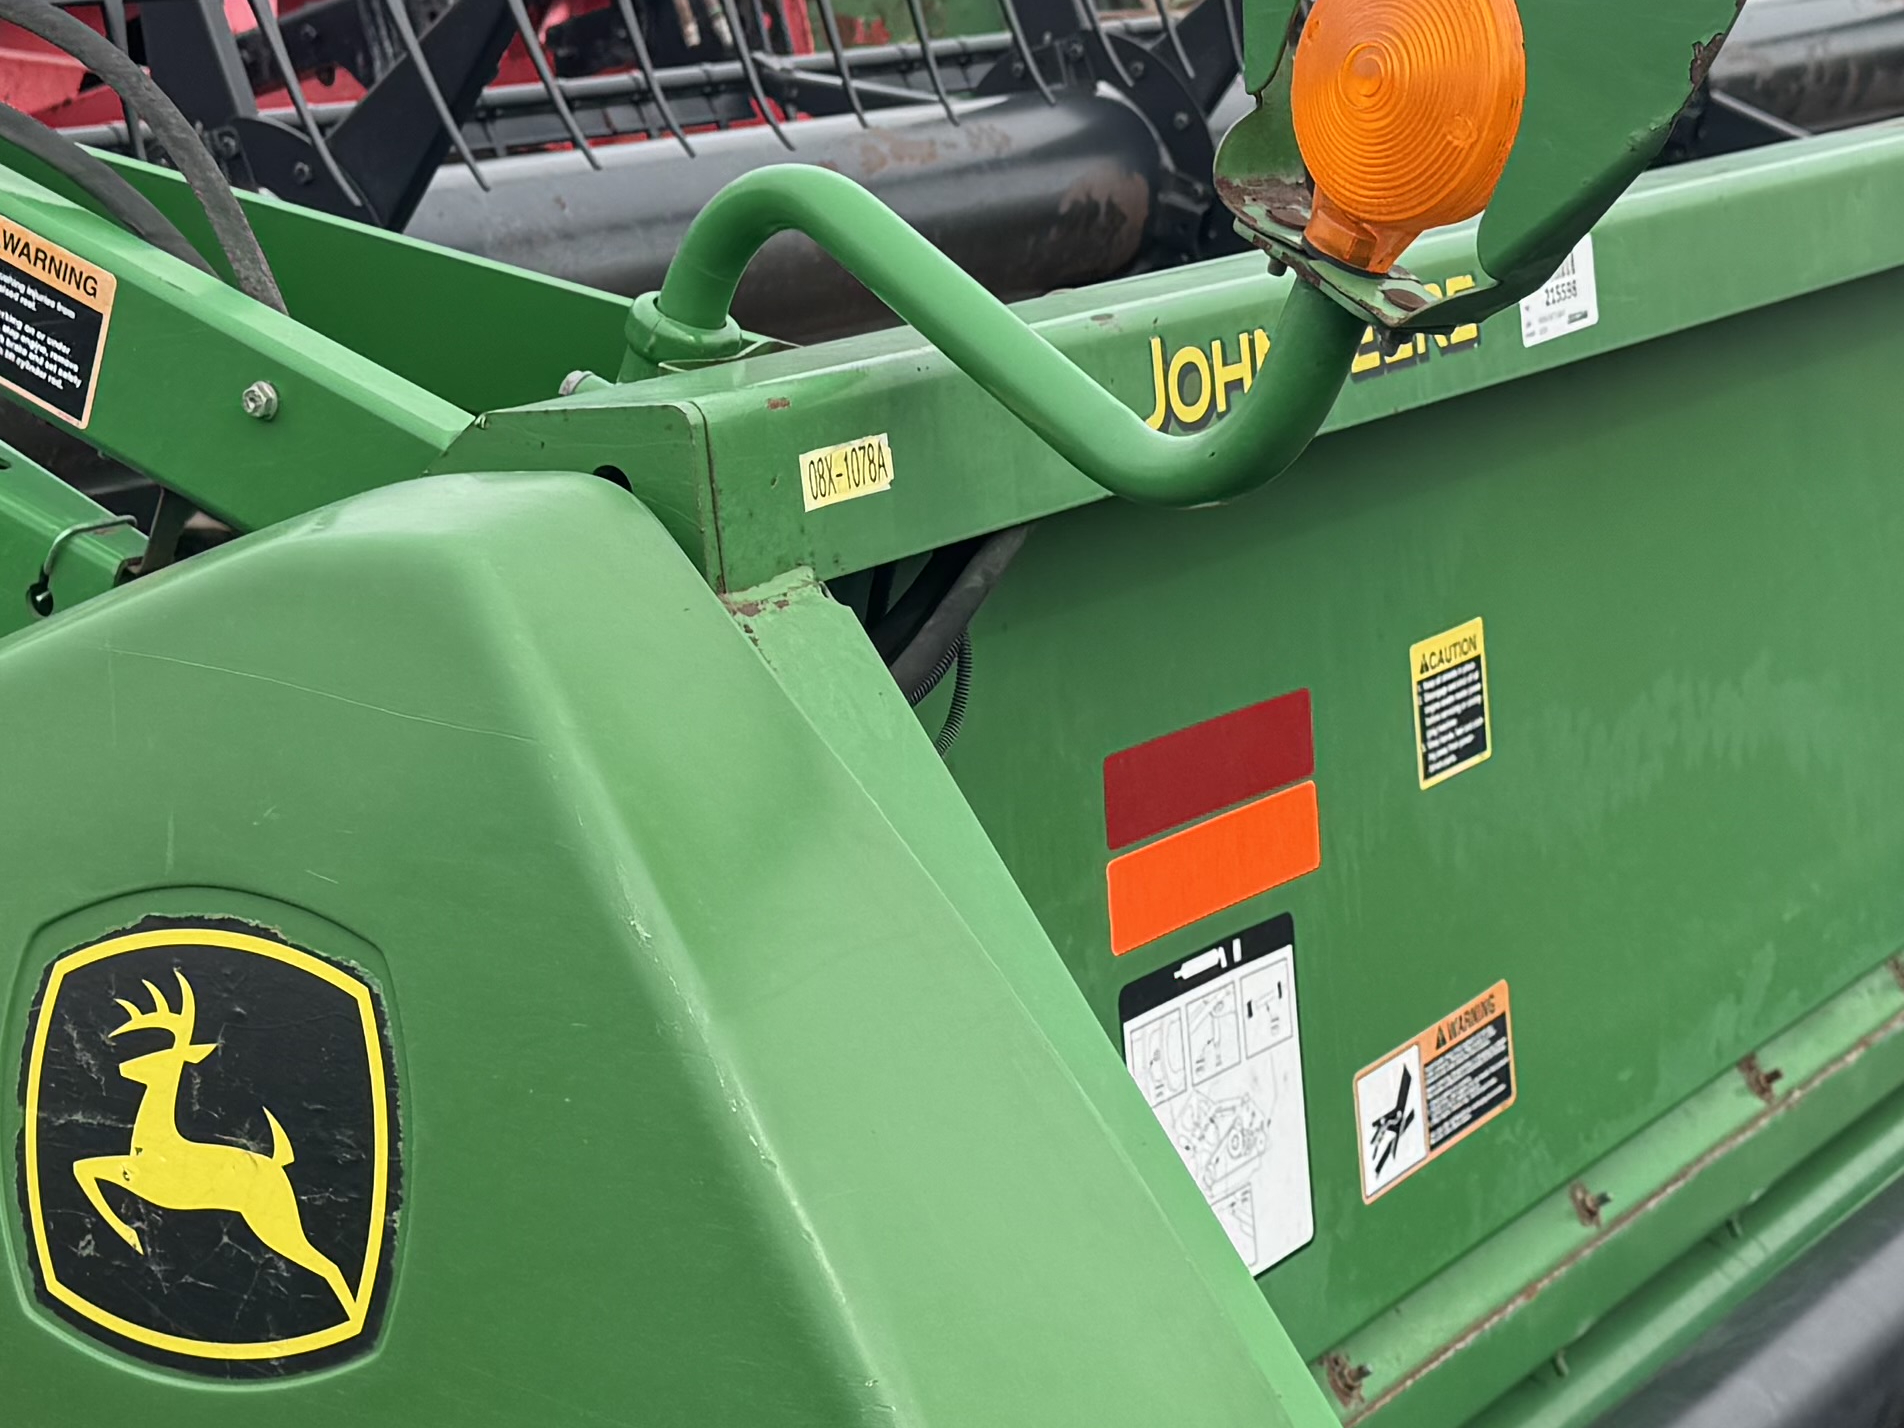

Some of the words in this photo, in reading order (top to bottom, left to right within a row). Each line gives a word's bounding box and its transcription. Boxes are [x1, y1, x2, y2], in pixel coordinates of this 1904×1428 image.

[2, 229, 98, 298] WARNING
[808, 440, 888, 501] 08X-1078A
[1428, 634, 1477, 670] CAUTION
